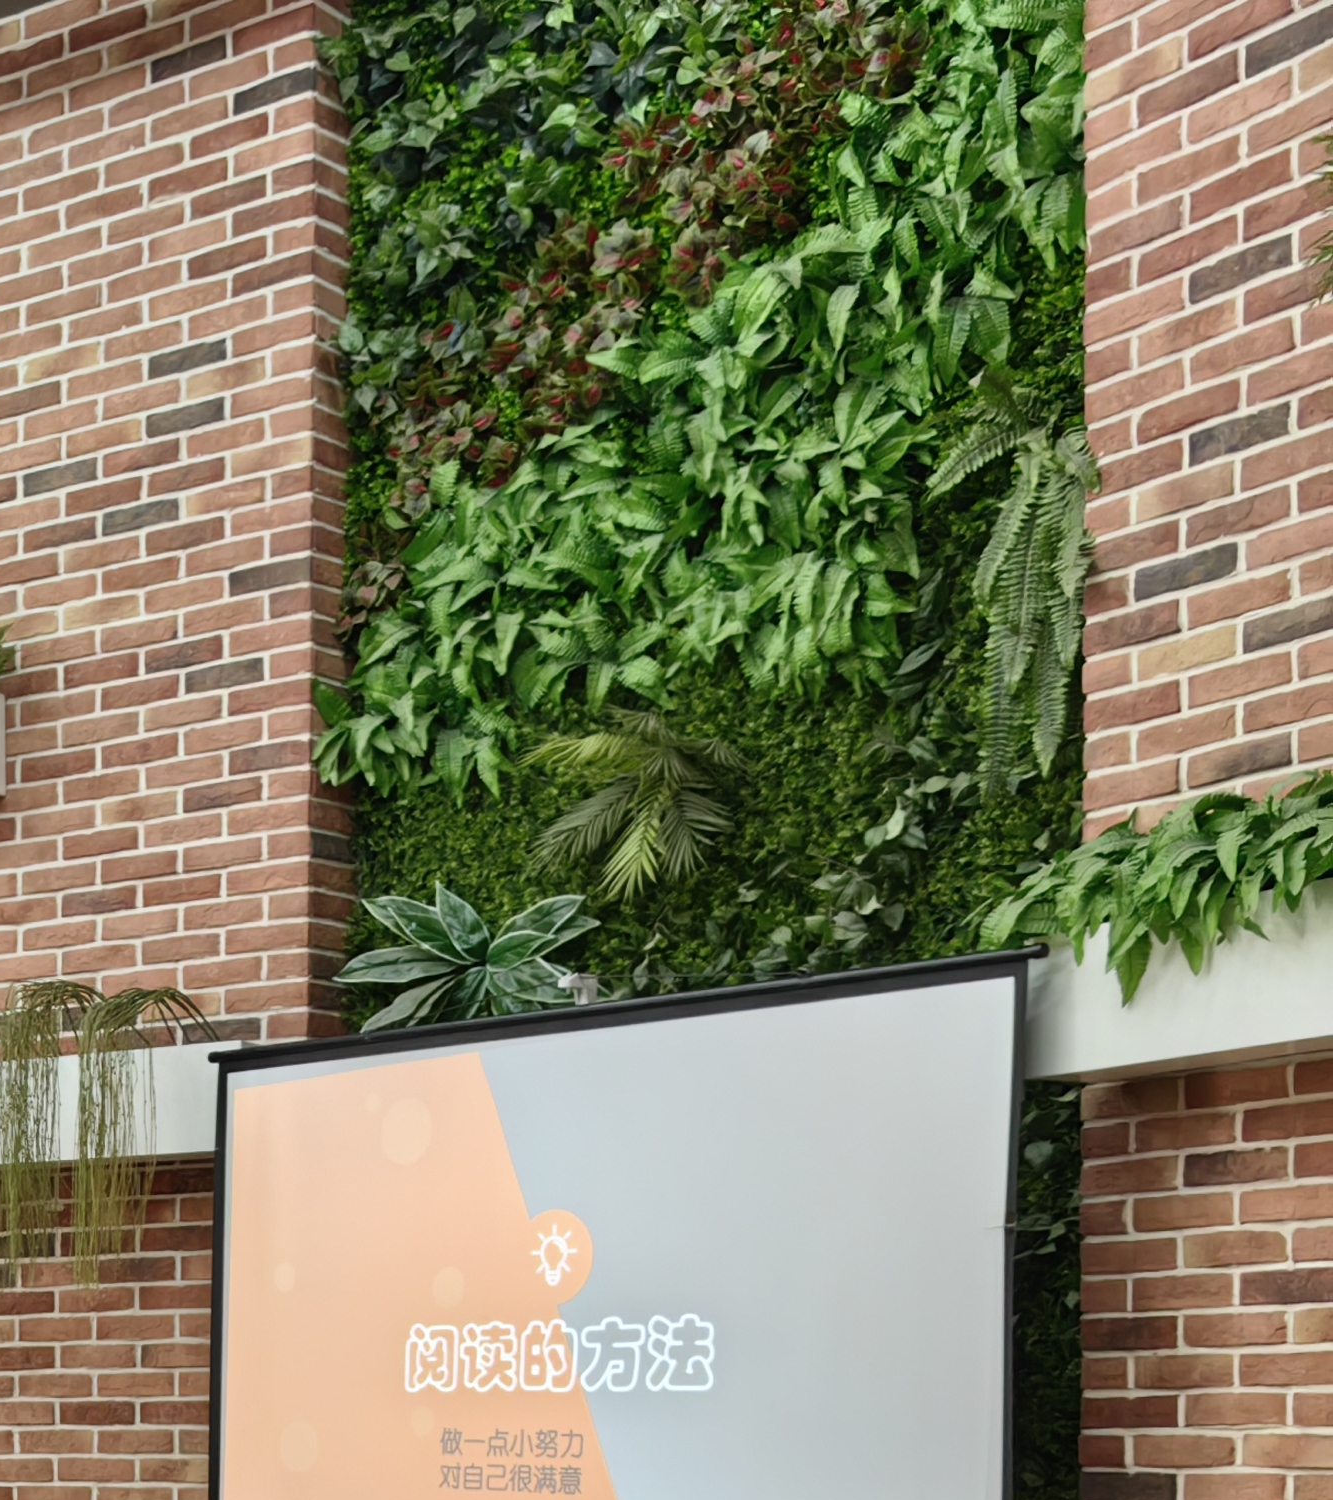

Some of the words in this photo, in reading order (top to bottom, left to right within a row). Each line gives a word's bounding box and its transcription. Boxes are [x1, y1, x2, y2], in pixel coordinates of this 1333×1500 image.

[404, 1313, 715, 1393] 阅读的方法
[439, 1427, 584, 1460] 做一点小努力
[438, 1463, 583, 1495] 对自己很满意
